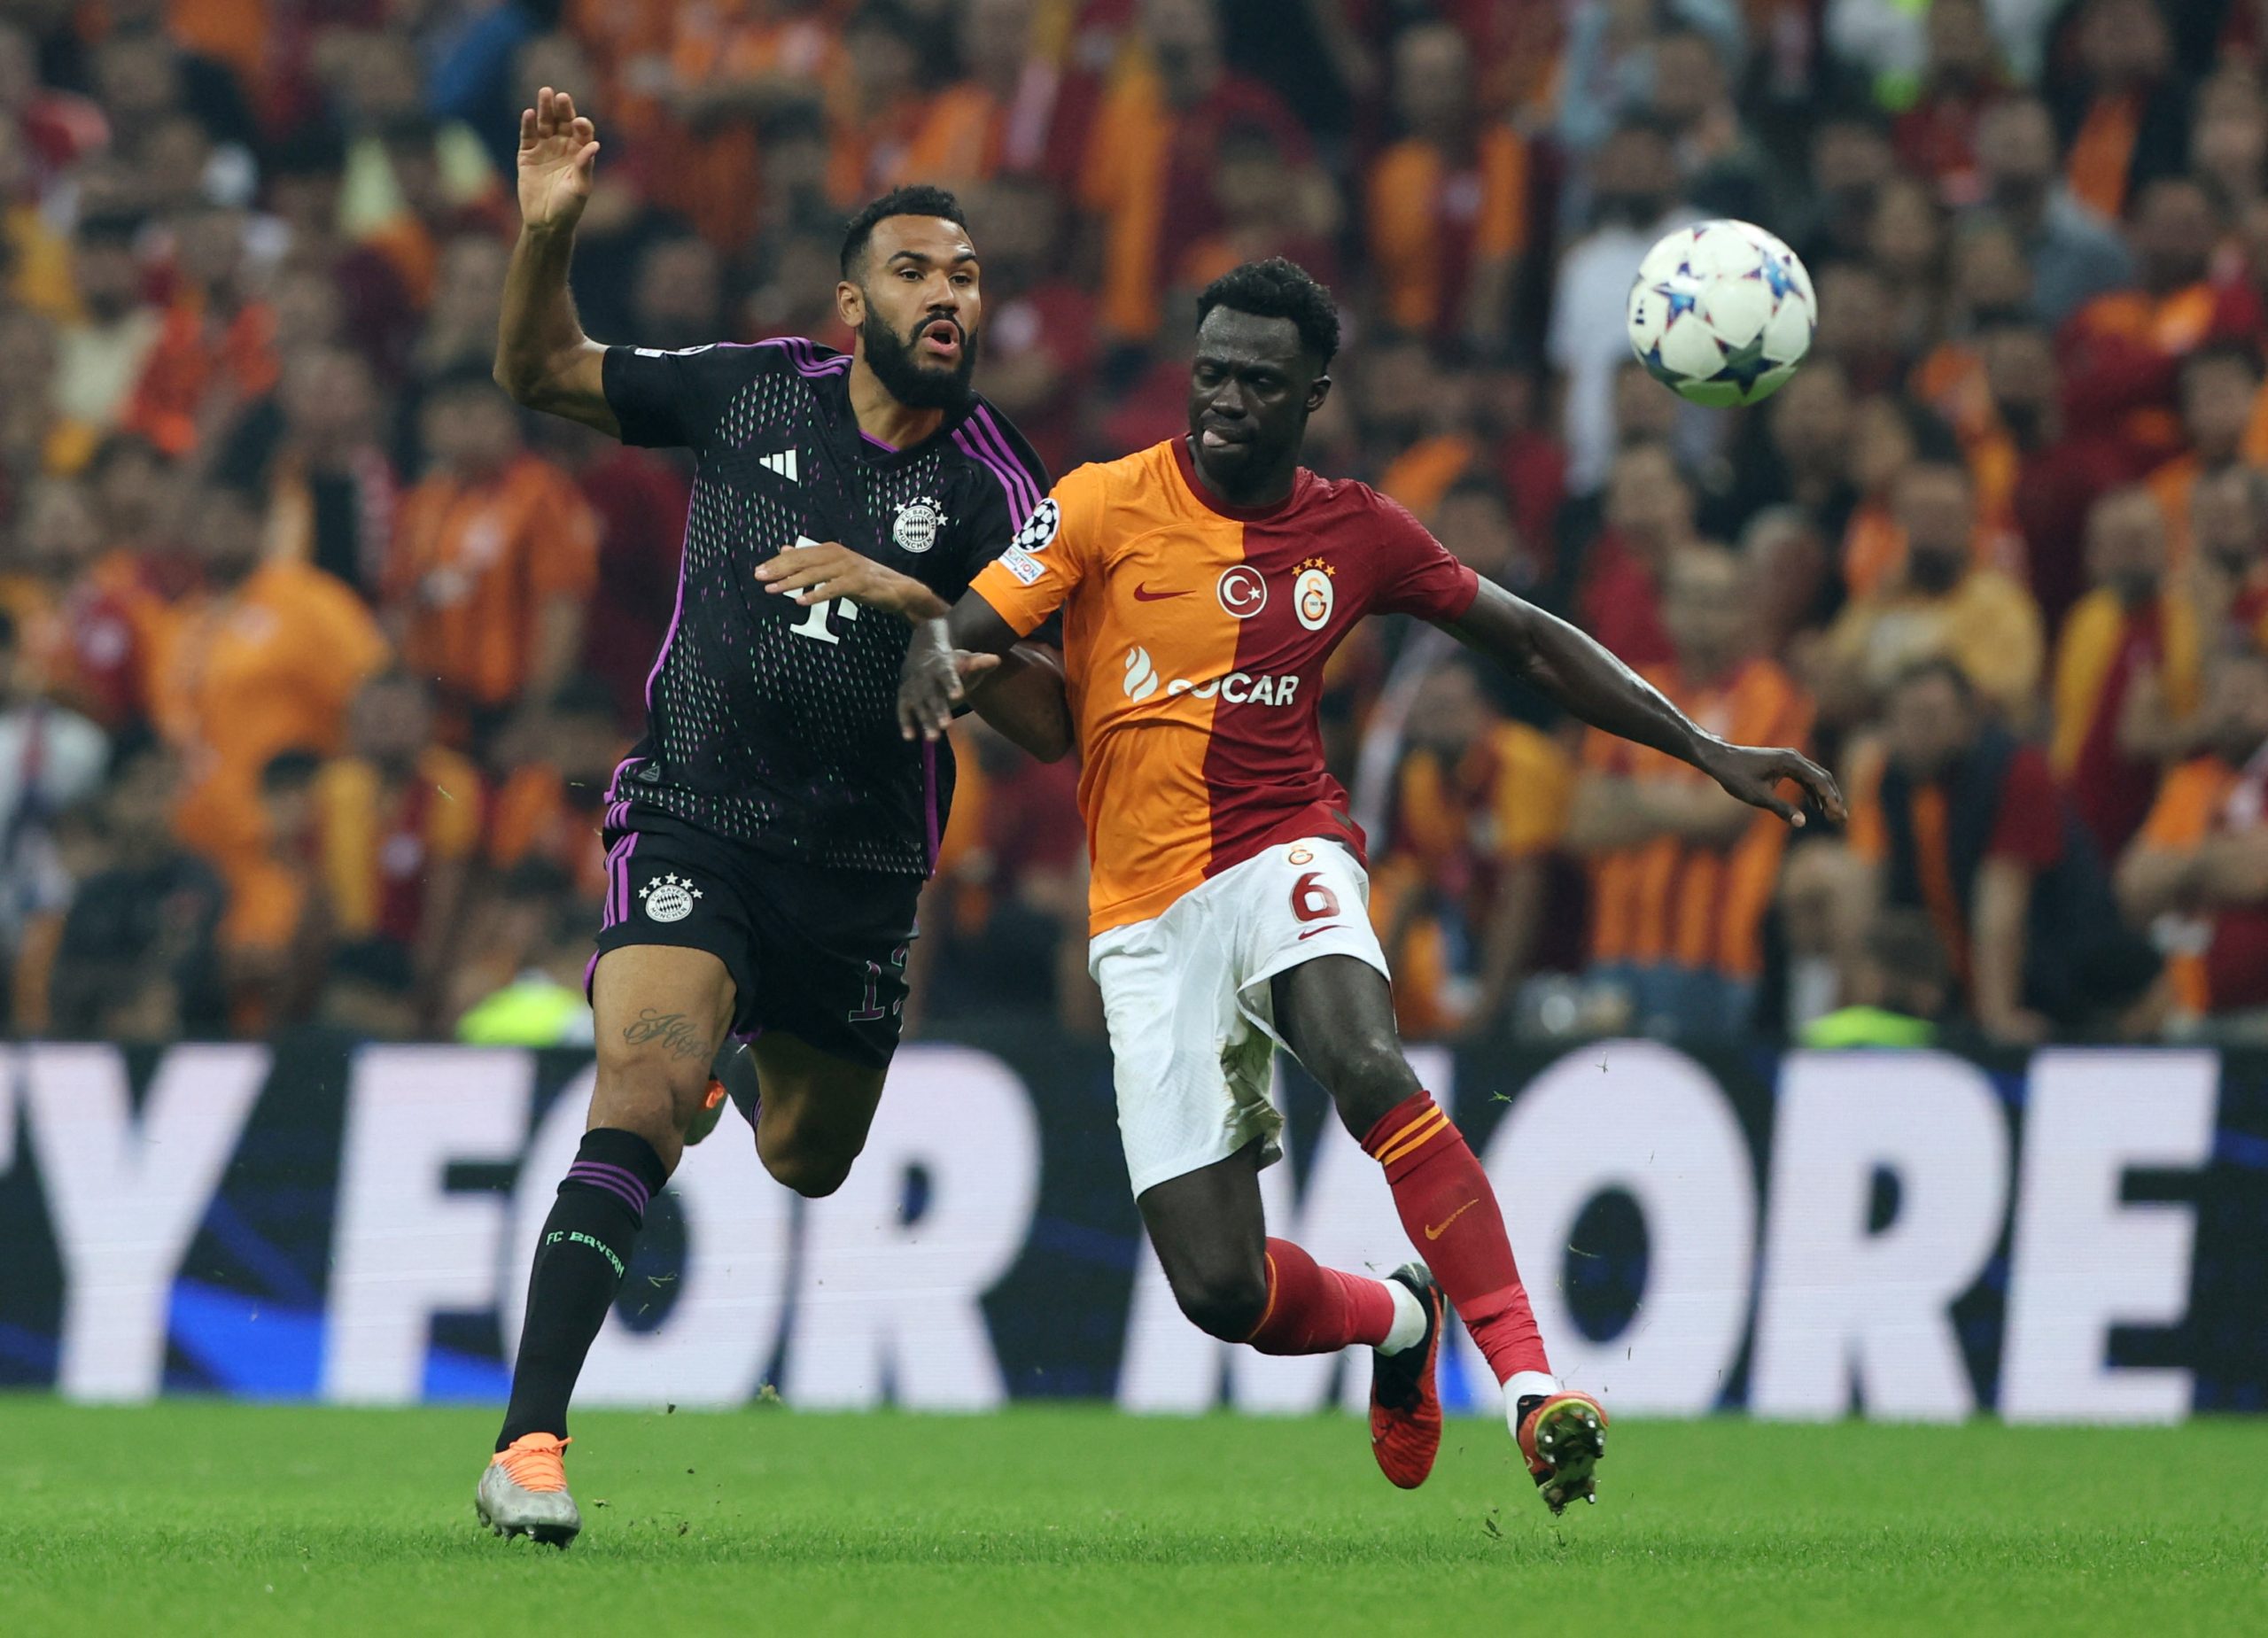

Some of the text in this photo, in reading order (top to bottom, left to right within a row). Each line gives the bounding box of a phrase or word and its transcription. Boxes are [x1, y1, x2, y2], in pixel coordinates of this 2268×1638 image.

[913, 508, 936, 531] BAYERN
[660, 887, 689, 903] BAYERN
[1290, 871, 1341, 925] 6
[0, 1041, 2220, 1424] Y FOR MORE
[545, 1230, 626, 1279] FC BAYERN
